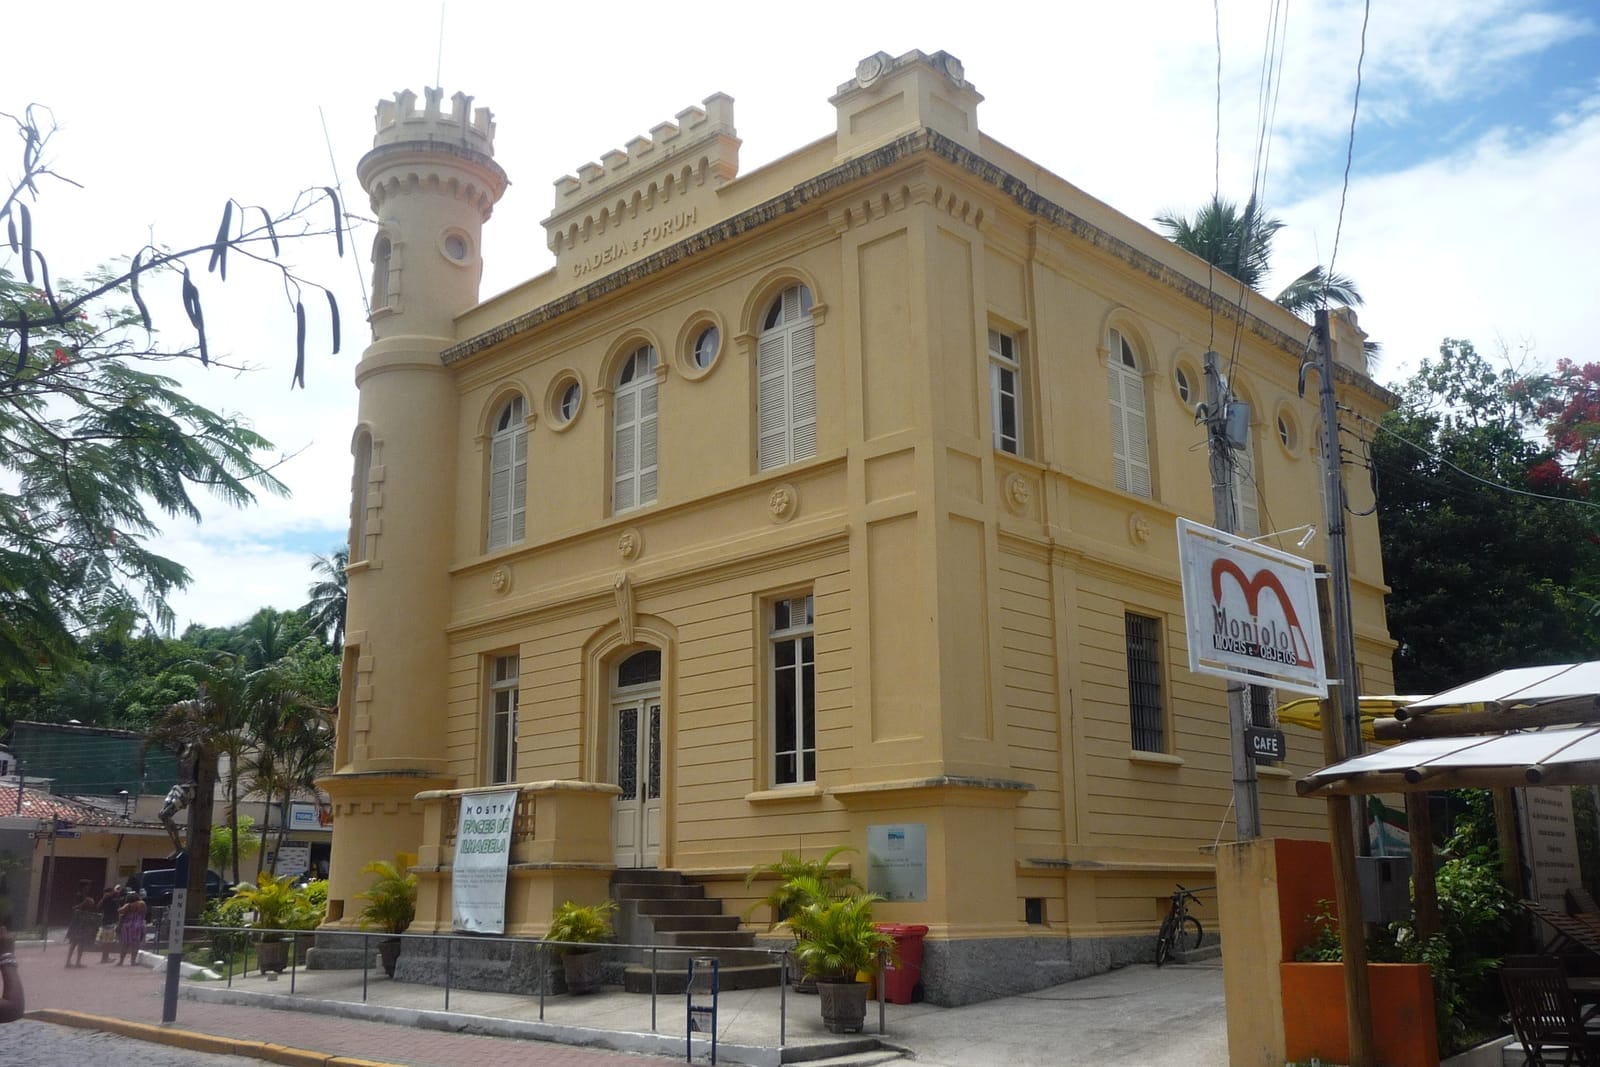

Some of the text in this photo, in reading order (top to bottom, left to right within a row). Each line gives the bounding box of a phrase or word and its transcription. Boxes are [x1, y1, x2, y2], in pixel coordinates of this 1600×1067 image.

[572, 241, 629, 278] CADEIA
[641, 206, 697, 247] FORUM
[1212, 604, 1289, 654] Monjolo
[1248, 646, 1254, 656] e
[1260, 646, 1297, 665] OBJETOS
[1253, 734, 1279, 752] CAFÉ
[466, 804, 511, 815] MOSTRA
[497, 817, 511, 833] DE
[460, 838, 507, 854] ILHABELA
